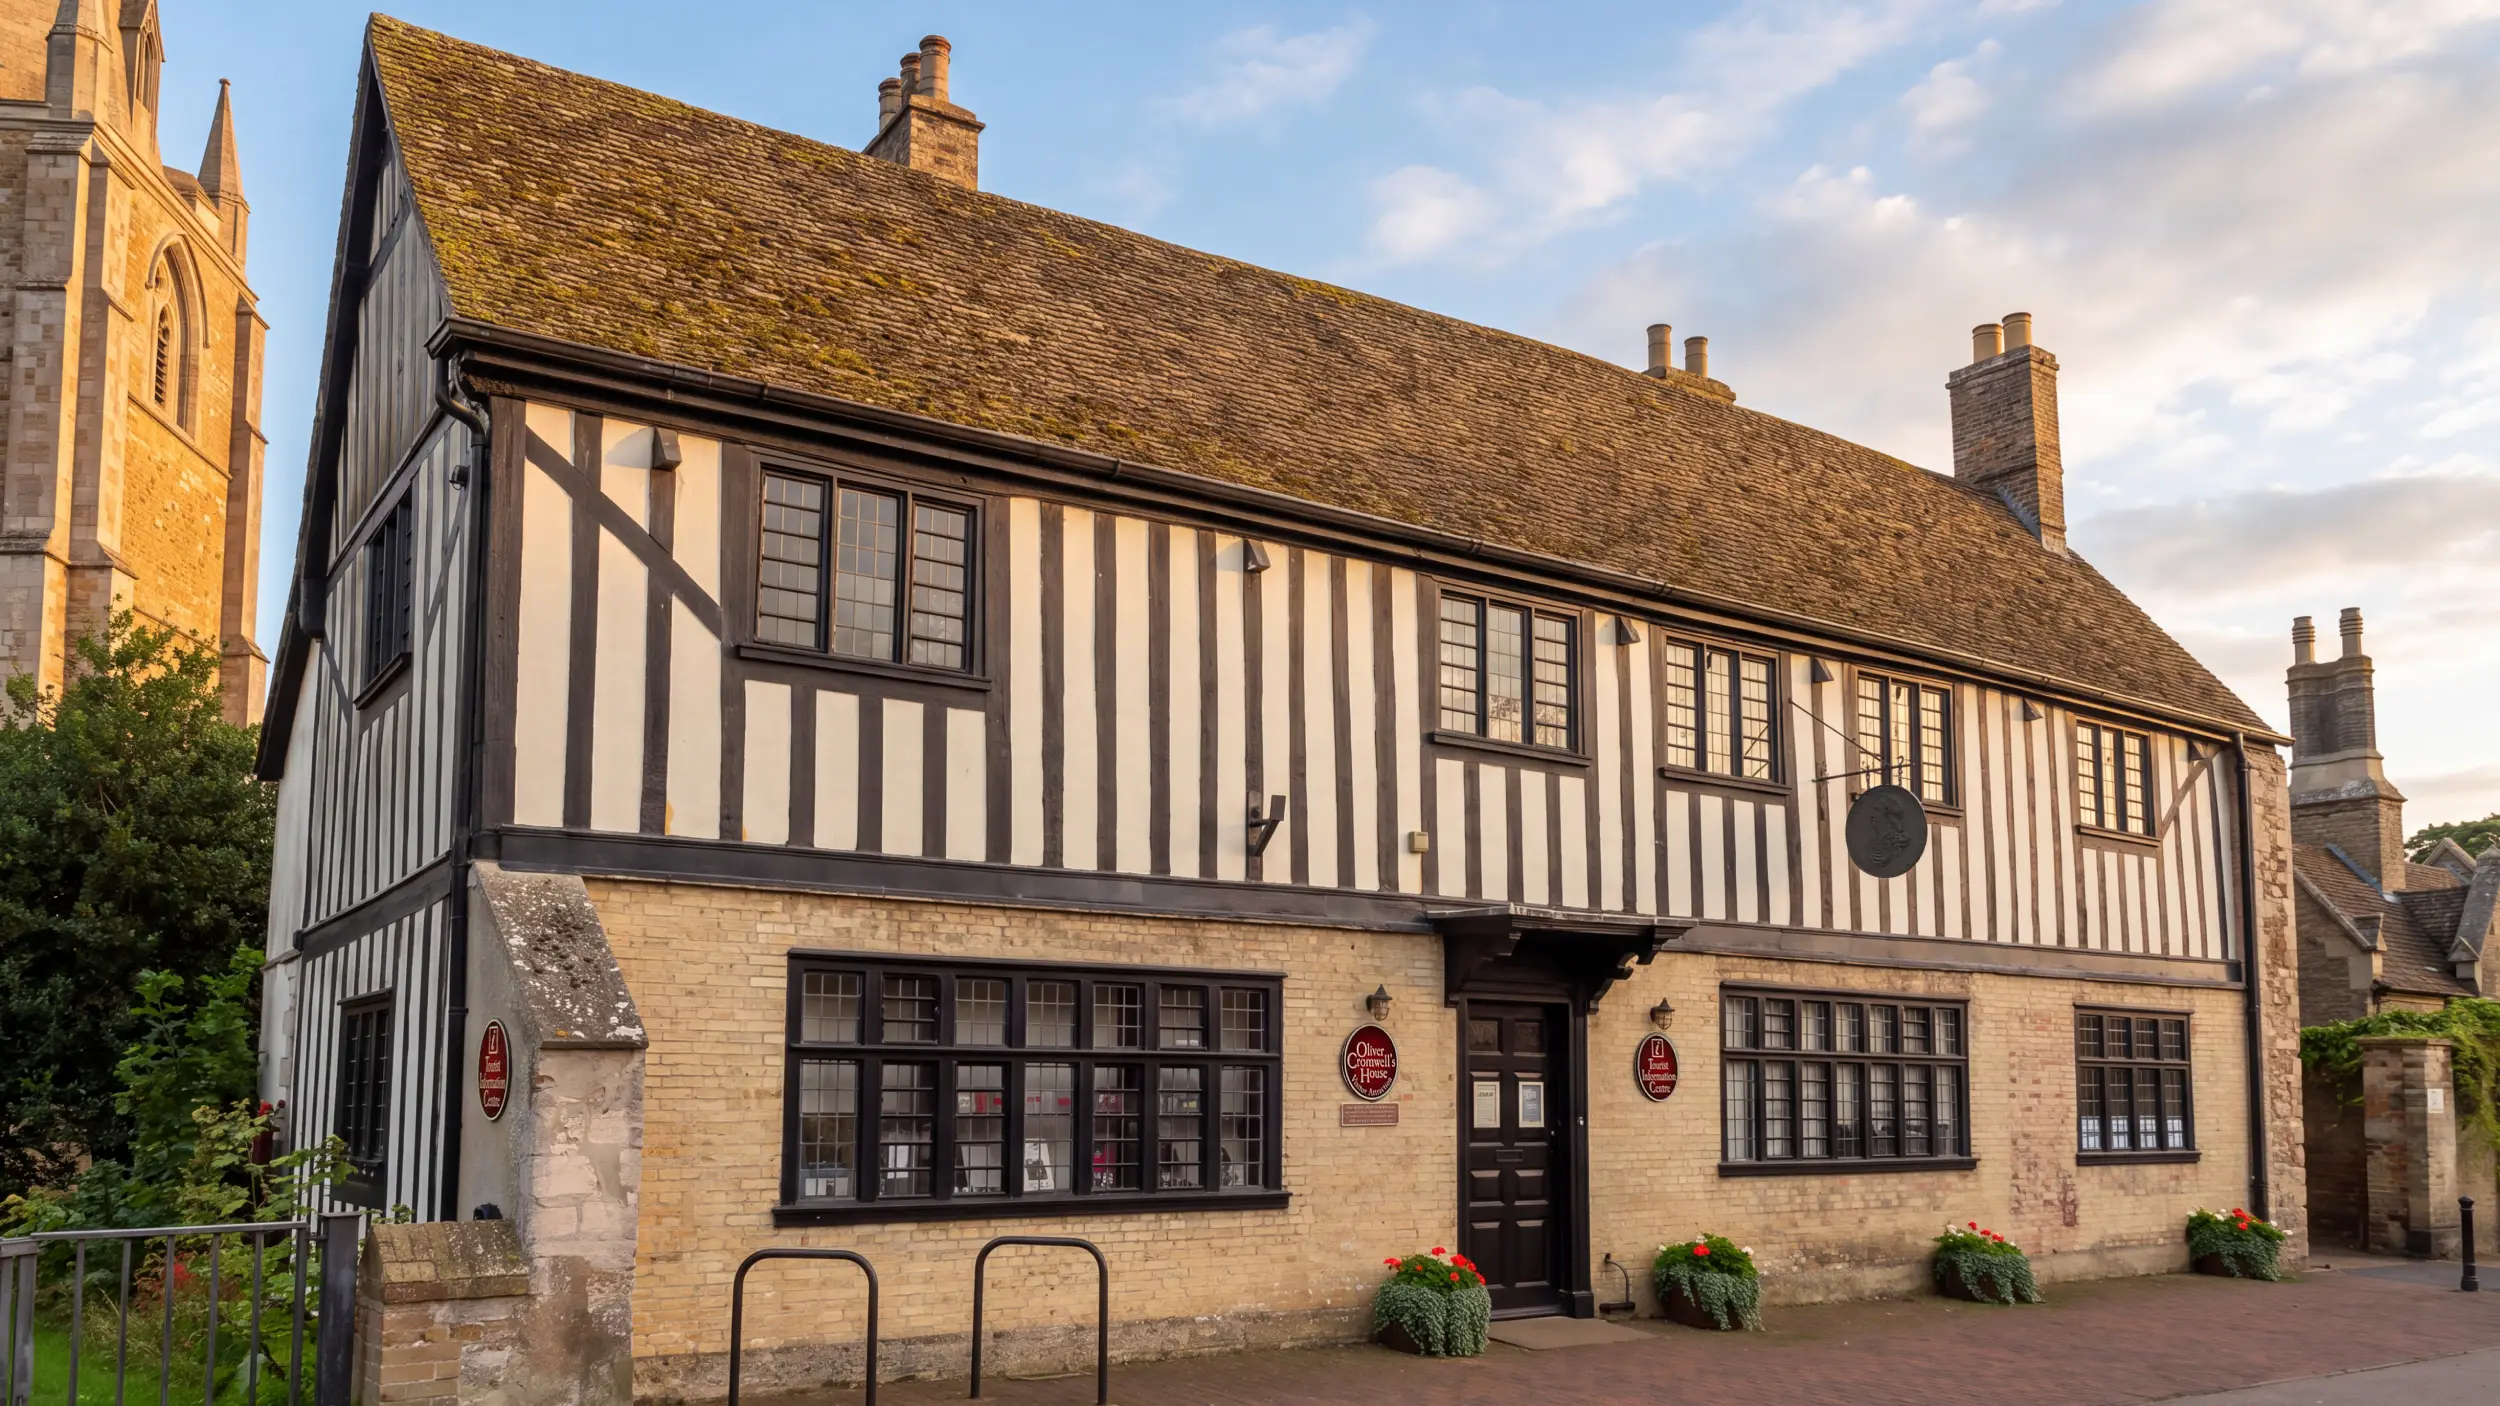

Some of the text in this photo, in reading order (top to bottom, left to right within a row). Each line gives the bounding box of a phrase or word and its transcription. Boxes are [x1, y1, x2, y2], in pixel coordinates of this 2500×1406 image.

[1356, 1041, 1384, 1058] Oliver
[1347, 1052, 1396, 1069] Cromwell's
[1647, 1058, 1669, 1070] Tourist
[1360, 1068, 1388, 1083] House
[1641, 1069, 1677, 1081] Information
[1351, 1073, 1393, 1096] Visitor Attraction
[1649, 1081, 1671, 1093] Centre
